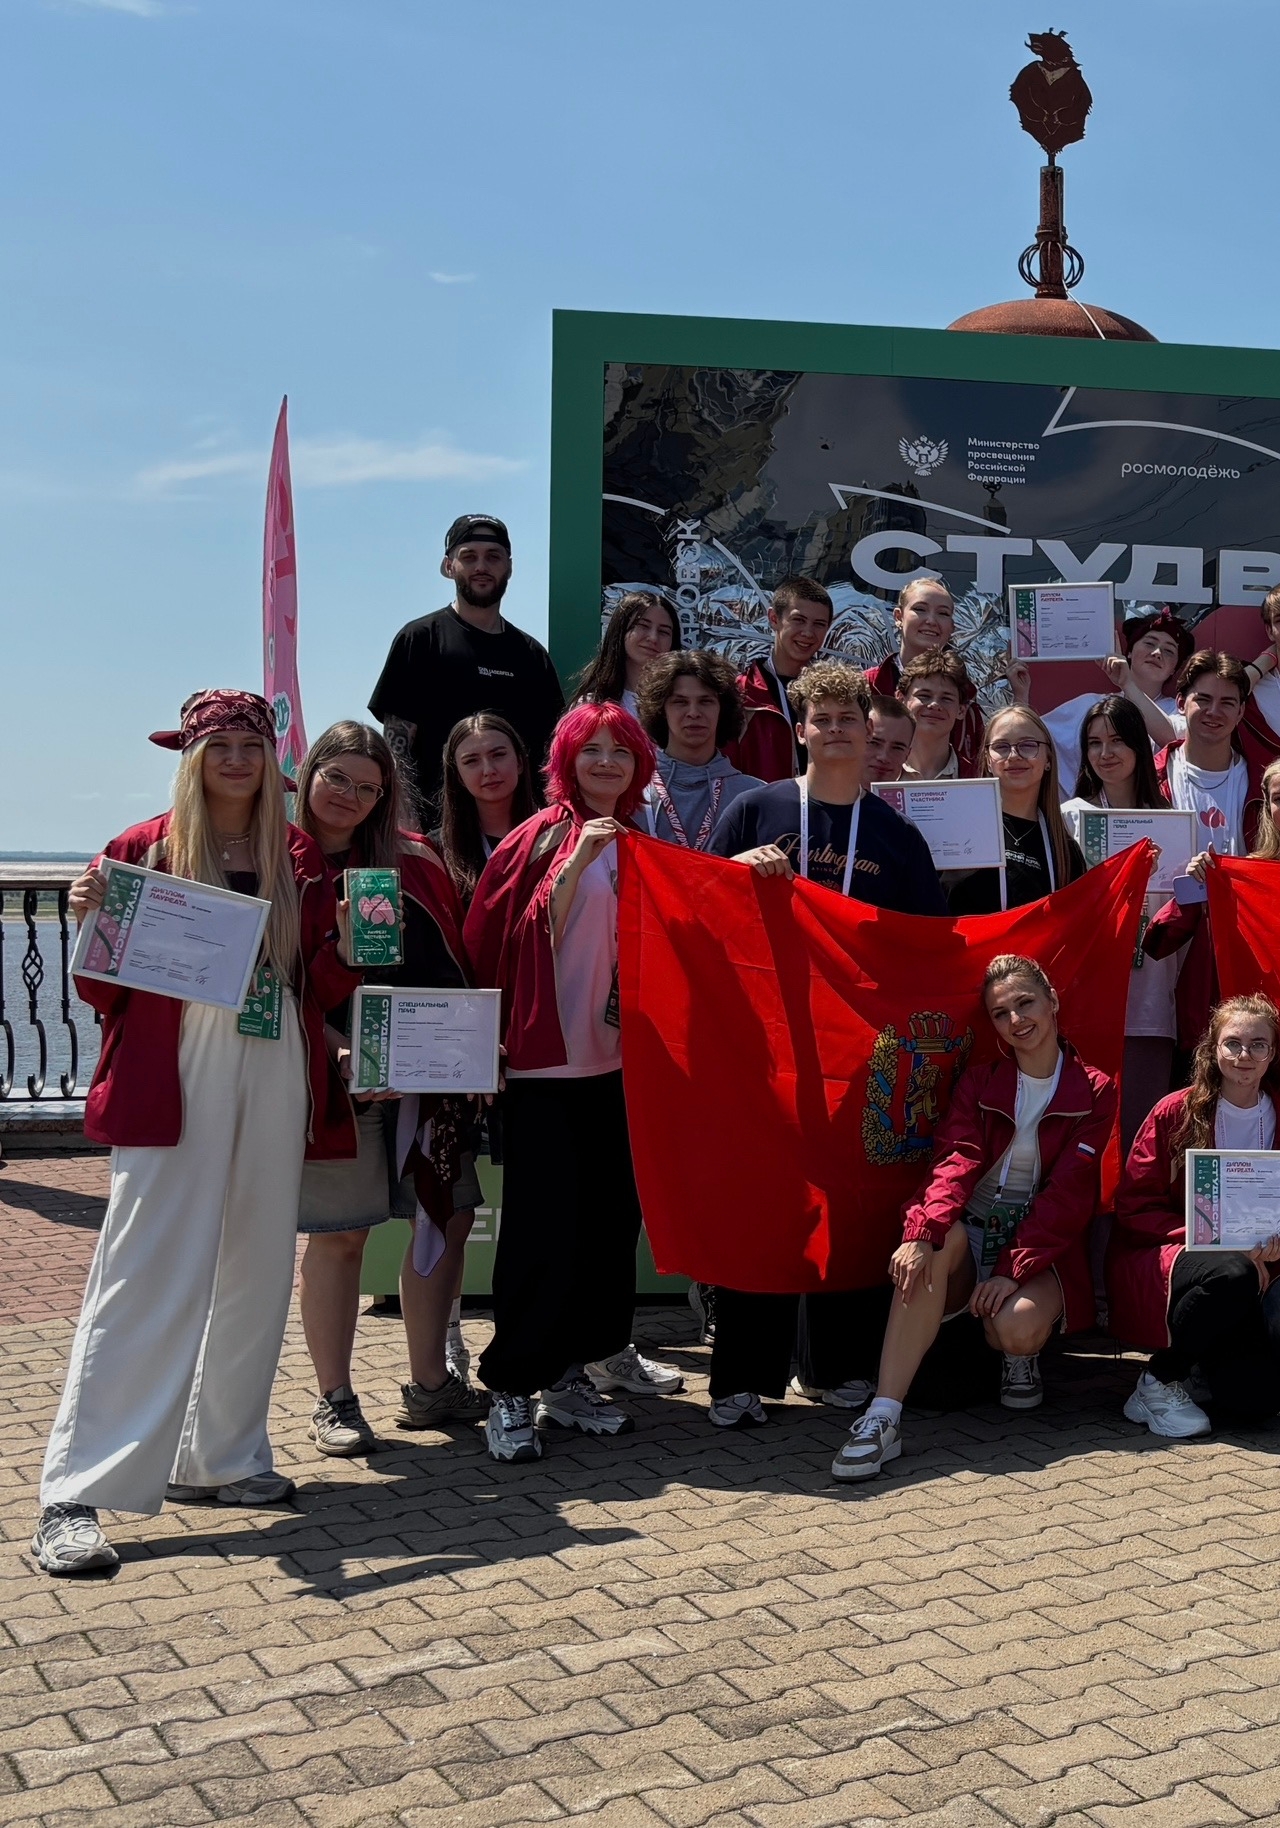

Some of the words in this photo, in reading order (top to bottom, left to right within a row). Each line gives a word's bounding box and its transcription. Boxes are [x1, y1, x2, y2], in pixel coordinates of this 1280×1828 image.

[967, 437, 1040, 450] Министерство
[967, 451, 1035, 461] просвещения
[967, 461, 1026, 473] Российской
[1121, 462, 1241, 479] росмолодёжь
[967, 472, 1026, 485] Федерации
[676, 518, 701, 652] АРОВСК
[151, 886, 185, 899] ДИПЛОМ
[149, 893, 188, 907] ЛАУРЕАТА
[108, 878, 142, 971] СТУДВЕСНА
[398, 1001, 449, 1009] СПЕЦИАЛЬНЫЙ
[378, 998, 390, 1085] СТУДВЕСНА
